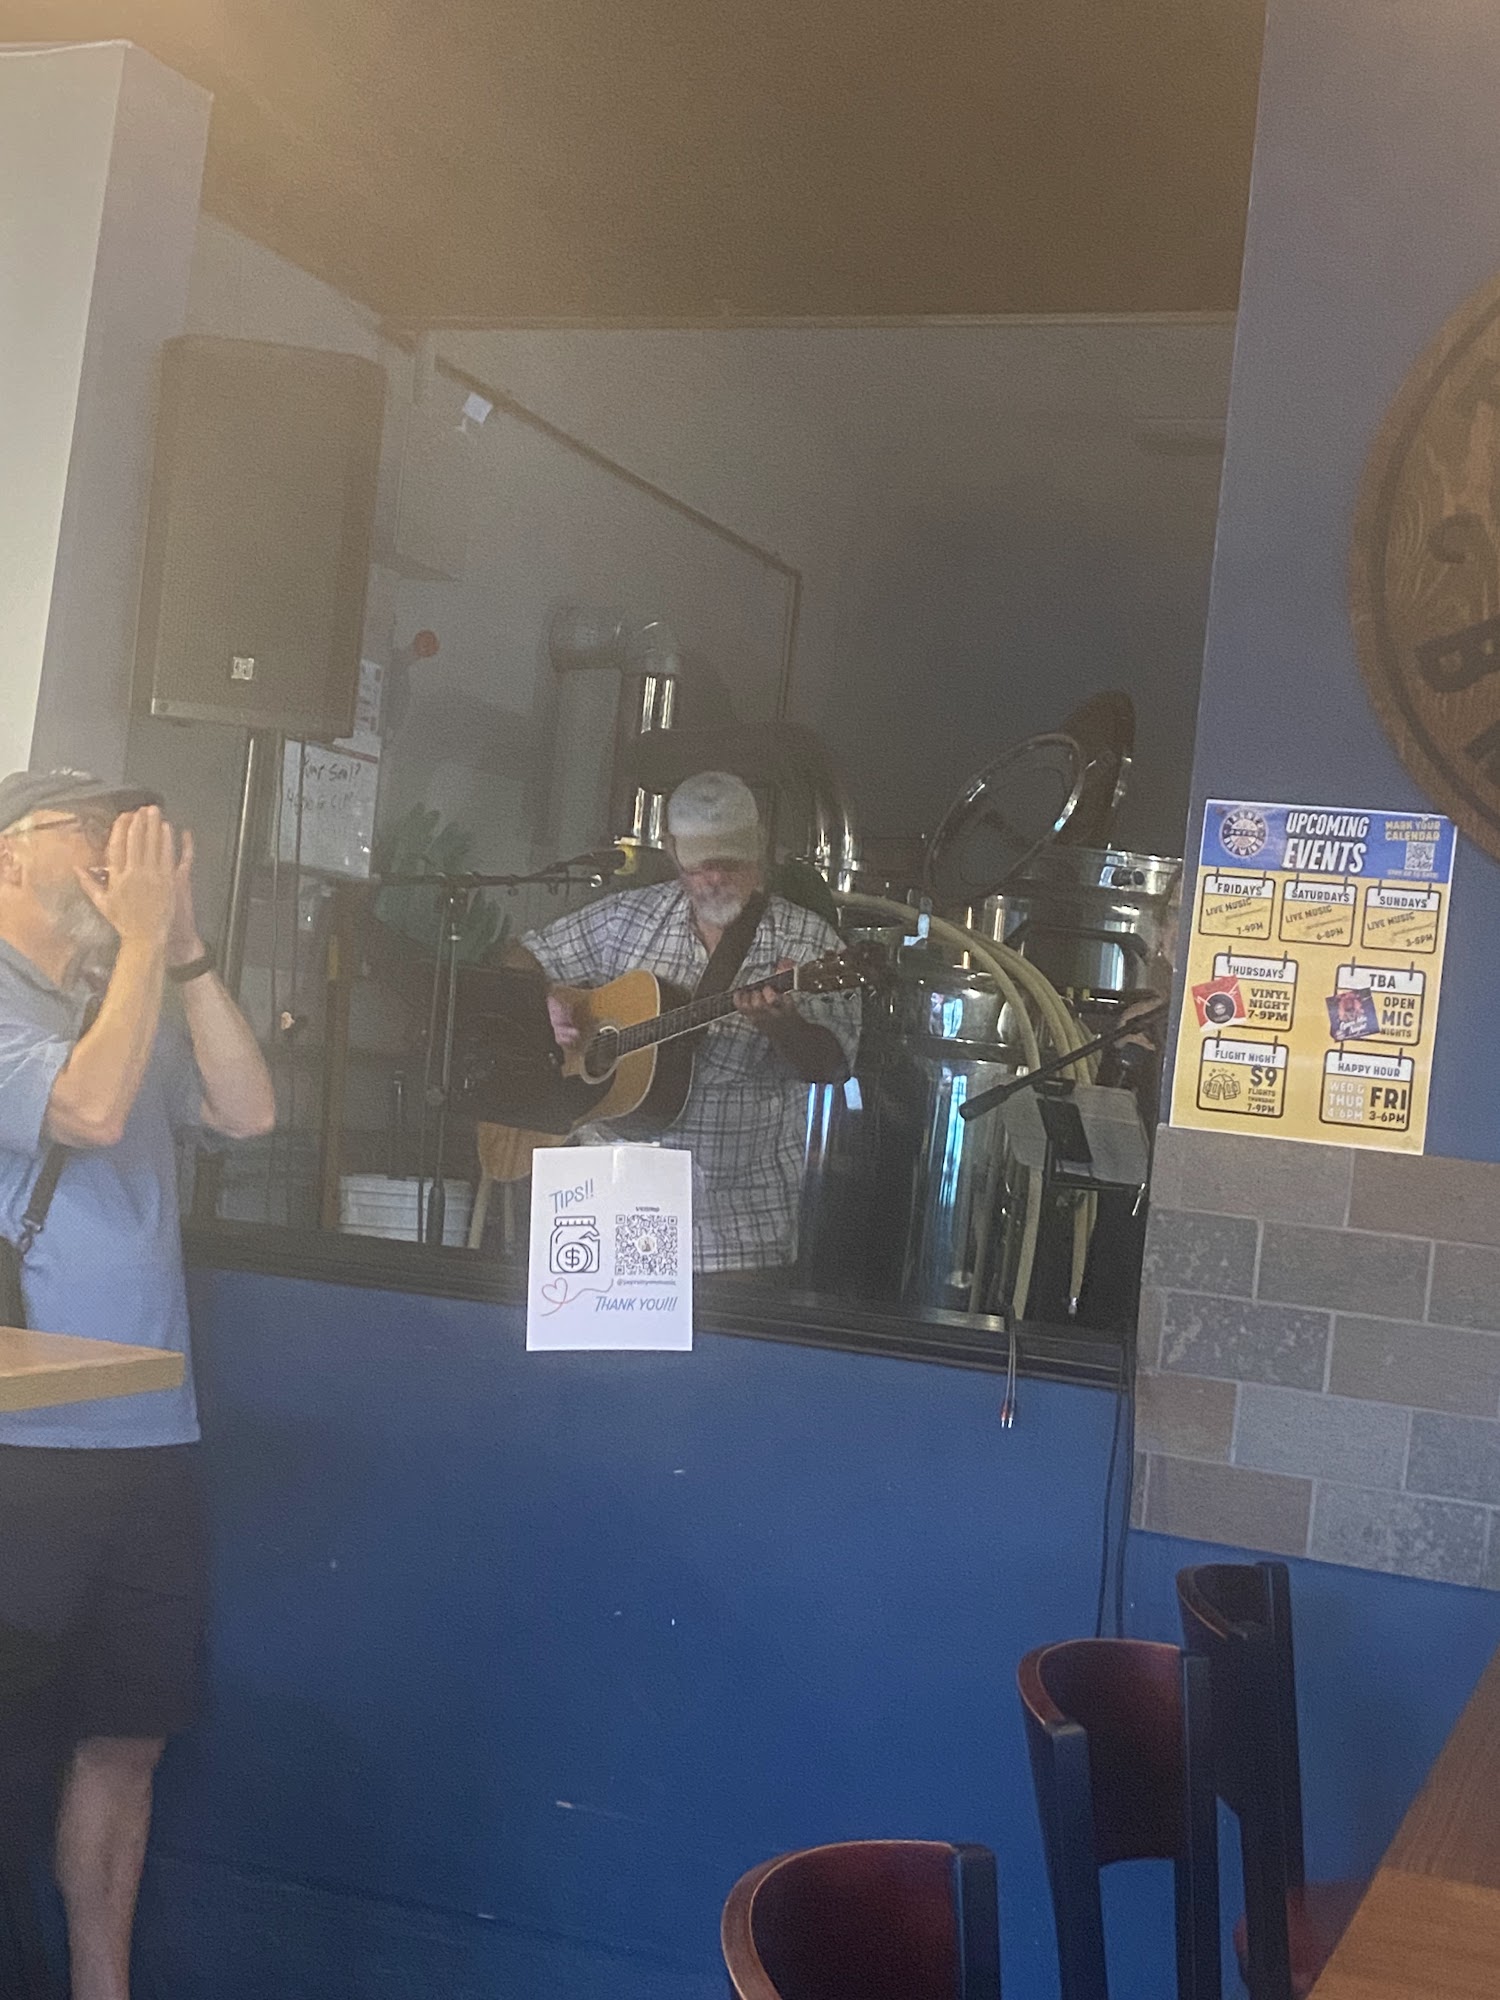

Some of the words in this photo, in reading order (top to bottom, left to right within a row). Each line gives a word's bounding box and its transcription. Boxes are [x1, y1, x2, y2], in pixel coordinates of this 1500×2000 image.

[1286, 812, 1369, 838] UPCOMING
[1385, 821, 1412, 830] MARK
[1415, 821, 1440, 831] YOUR
[1385, 831, 1440, 841] CALENDAR
[1282, 838, 1367, 873] EVENTS
[1217, 883, 1262, 896] FRIDAYS
[1292, 890, 1349, 903] SATURDAYS
[1206, 906, 1224, 916] LIVE
[1225, 898, 1251, 911] MUSIC
[1380, 896, 1427, 908] SUNDAYS
[1286, 913, 1303, 923] LIVE
[1305, 905, 1332, 917] MUSIC
[1367, 920, 1385, 931] LIVE
[1388, 912, 1415, 925] MUSIC
[1228, 965, 1284, 979] THURSDAYS
[1370, 974, 1396, 989] TBA
[1251, 988, 1290, 1000] VINYL
[1250, 999, 1289, 1010] NIGHT
[1384, 996, 1415, 1009] OPEN
[1248, 1010, 1288, 1022] 7-9PM
[1382, 1010, 1413, 1027] MIC
[1380, 1028, 1411, 1038] NIGHTS
[1215, 1050, 1246, 1061] FLIGHT
[1248, 1053, 1276, 1064] NIGHT
[1250, 1064, 1277, 1087] $9
[1338, 1063, 1371, 1075] HAPPY
[1373, 1067, 1400, 1077] HOUR
[1248, 1087, 1275, 1097] FLIGHTS
[1331, 1081, 1354, 1093] WED
[1328, 1093, 1363, 1107] THUR
[1370, 1086, 1407, 1110] FRI
[1247, 1103, 1275, 1113] 7-9PM
[1369, 1111, 1405, 1123] 3-6PM
[549, 1179, 594, 1214] TIPS!!
[595, 1296, 635, 1311] THANK
[640, 1296, 678, 1311] YOU!!!
